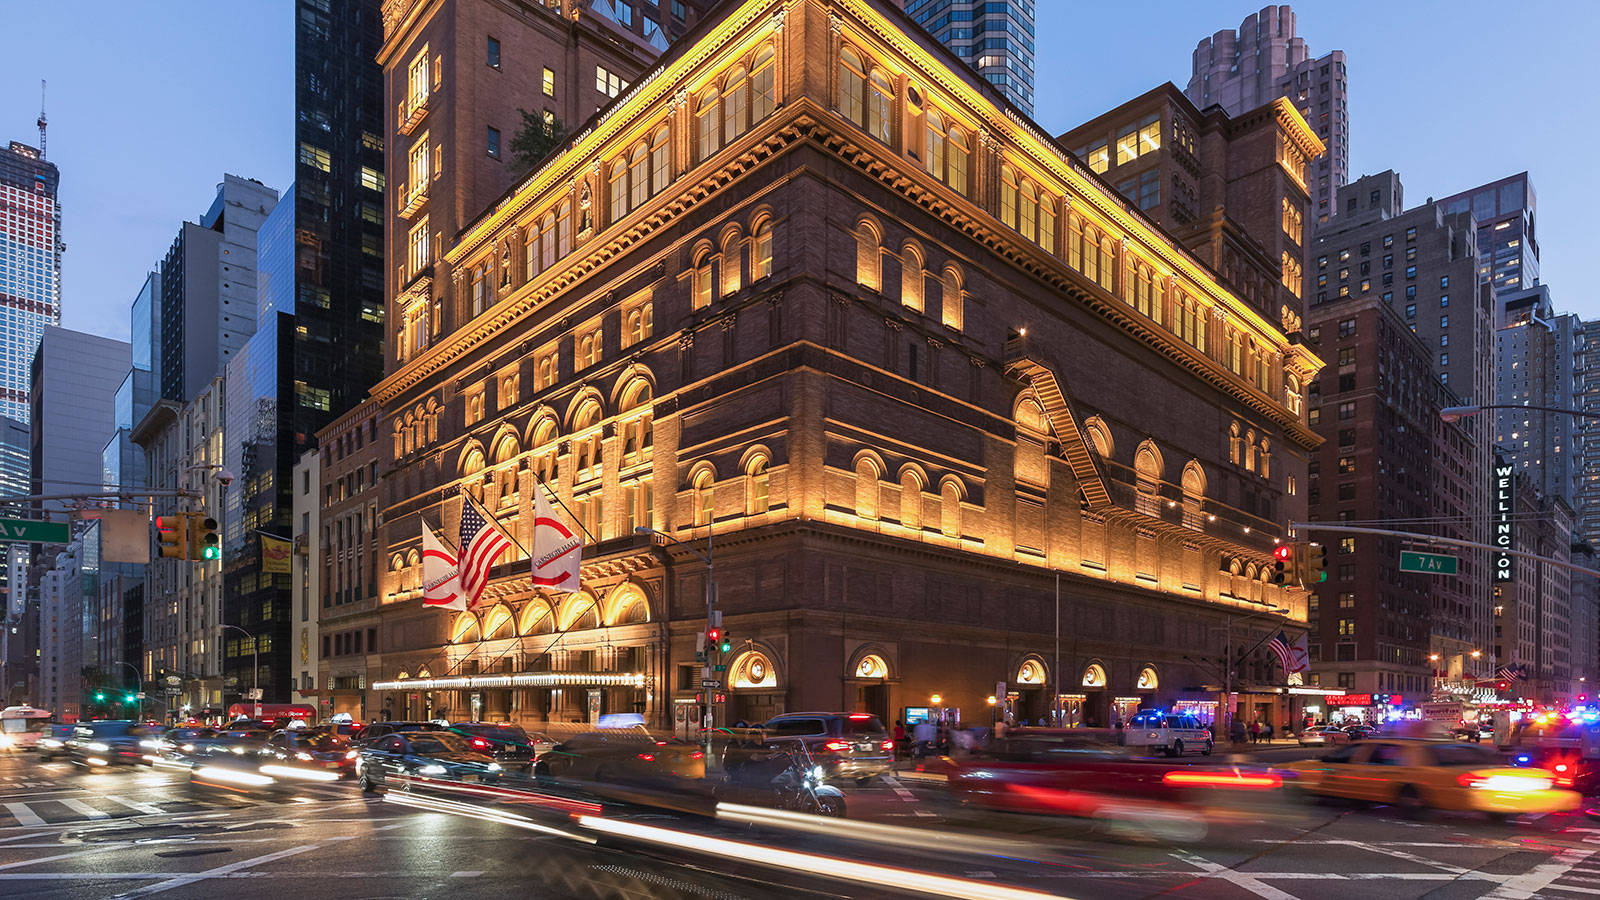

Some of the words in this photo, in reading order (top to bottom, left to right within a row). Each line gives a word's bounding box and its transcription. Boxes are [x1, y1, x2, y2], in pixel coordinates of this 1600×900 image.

[535, 548, 562, 567] CARNEGIE
[561, 539, 579, 552] HALL
[1419, 556, 1425, 569] 7
[1428, 558, 1442, 570] Av
